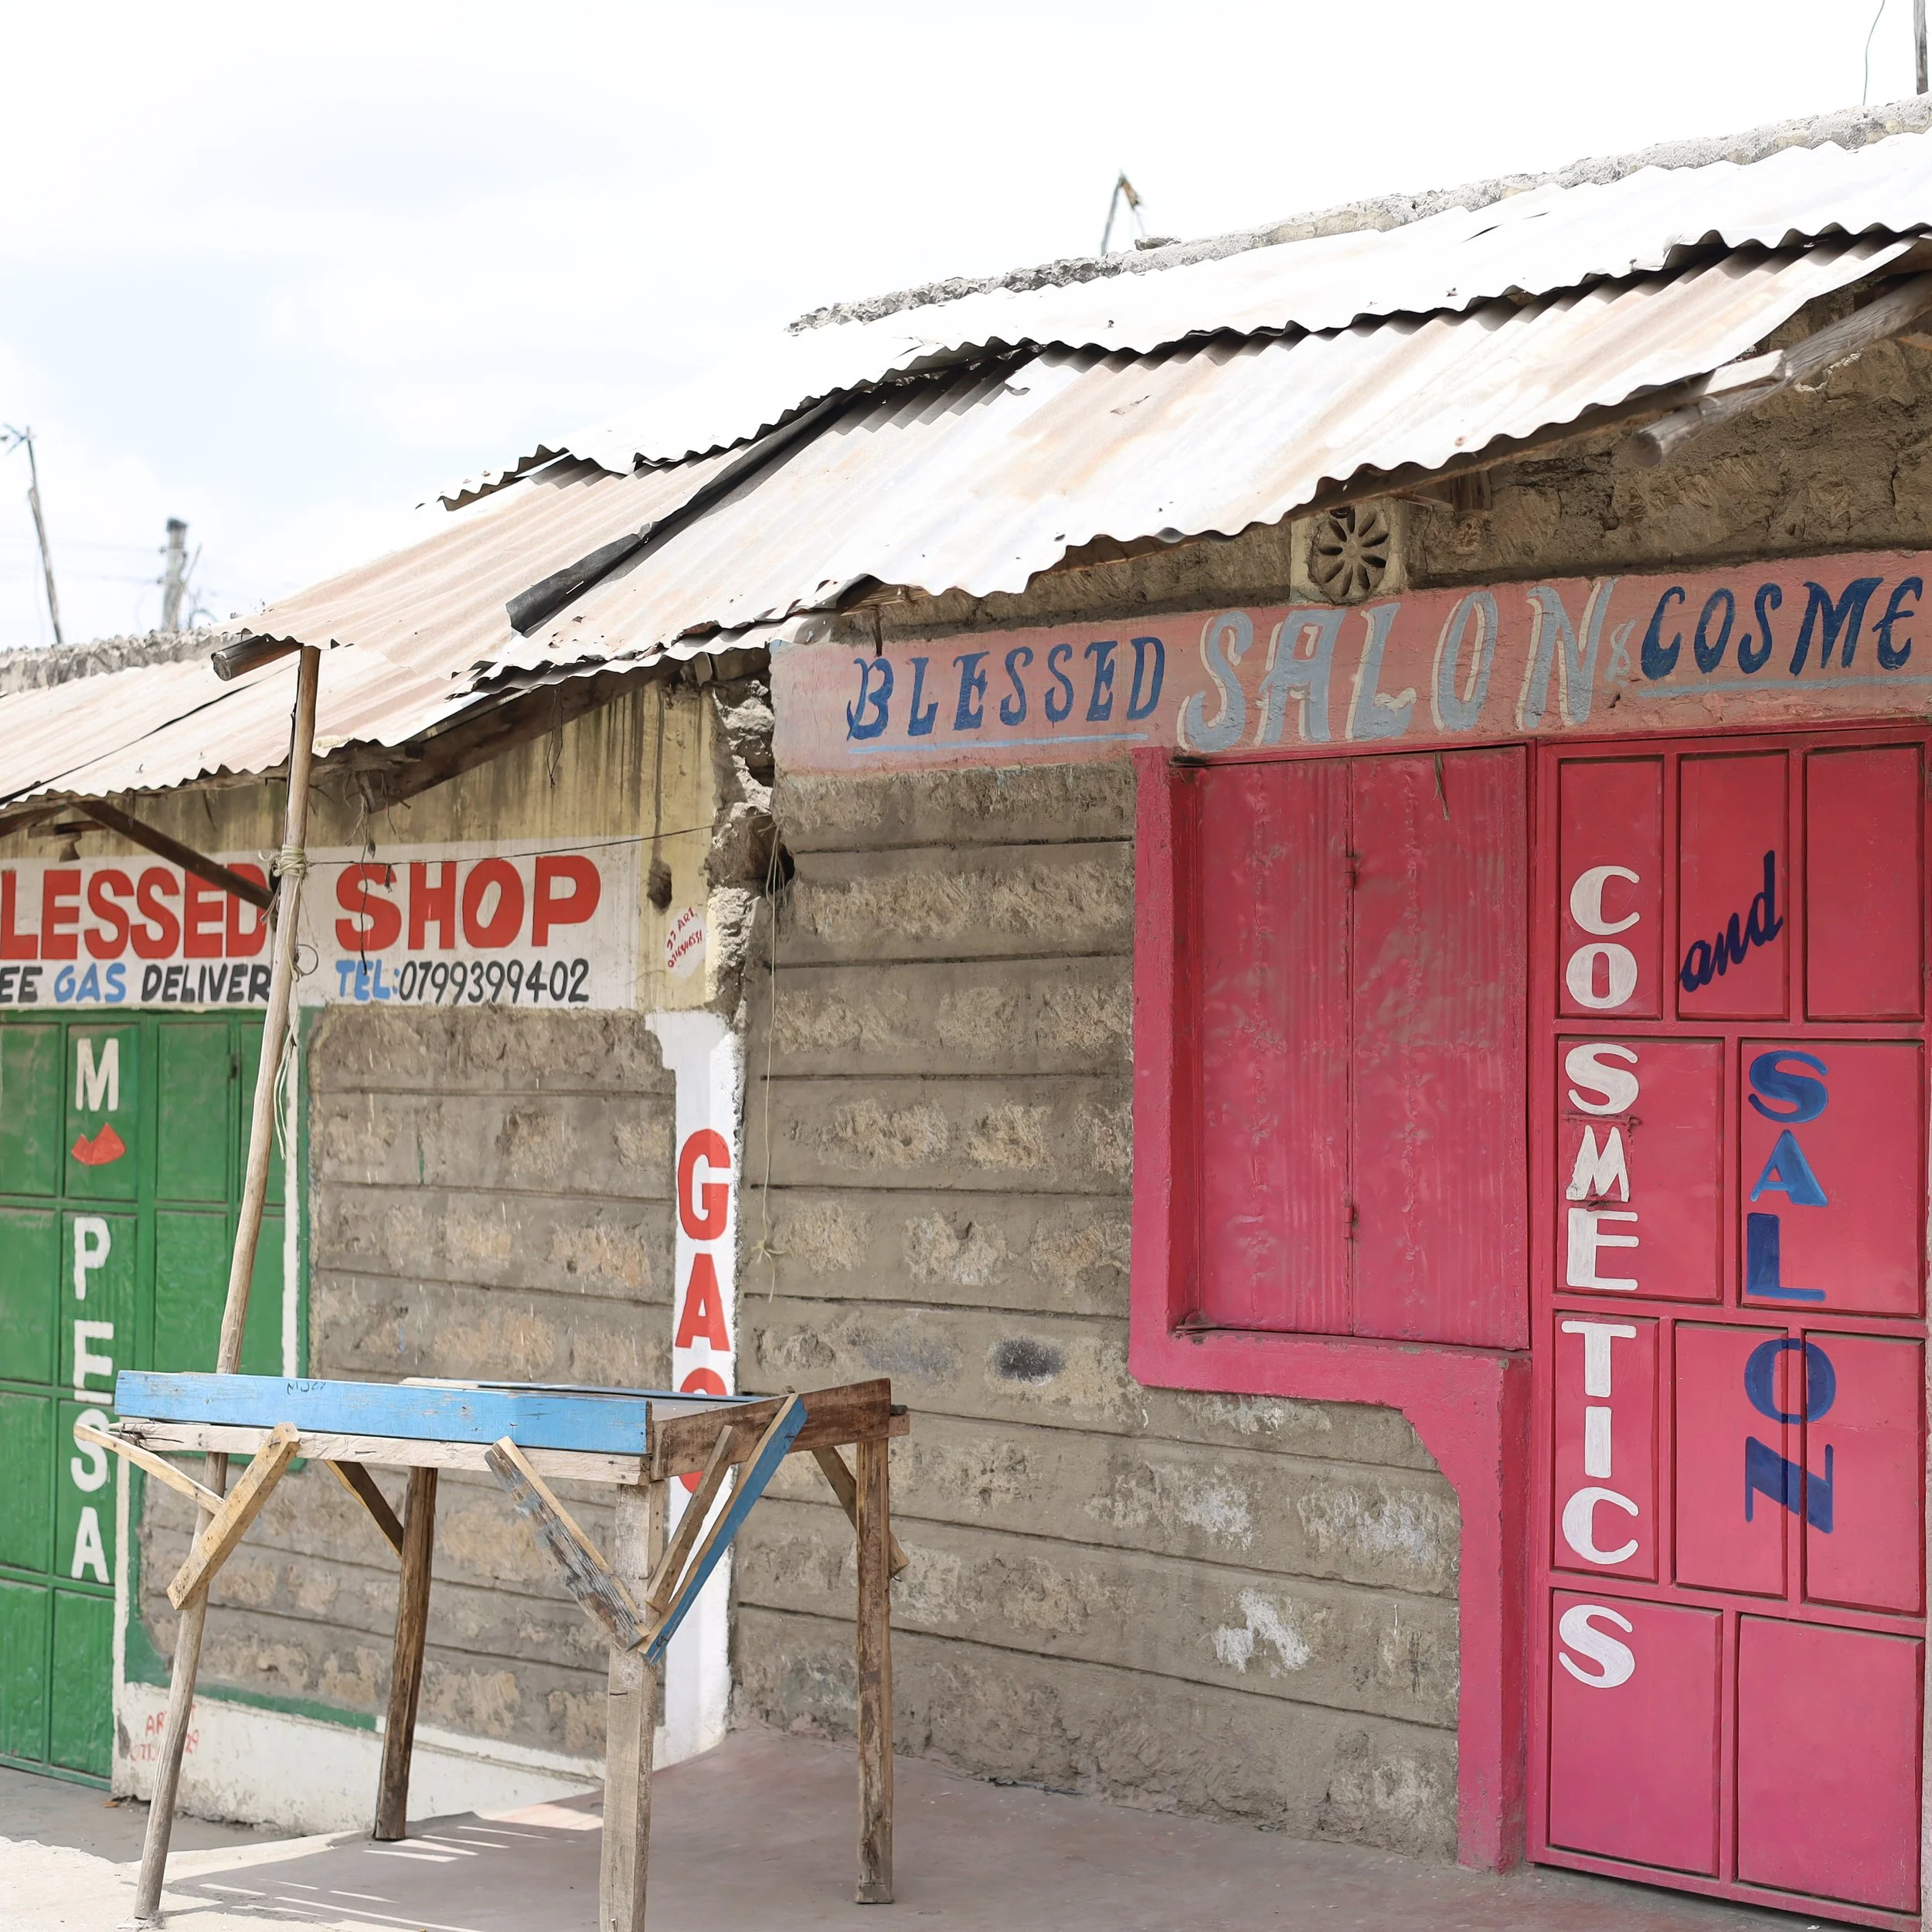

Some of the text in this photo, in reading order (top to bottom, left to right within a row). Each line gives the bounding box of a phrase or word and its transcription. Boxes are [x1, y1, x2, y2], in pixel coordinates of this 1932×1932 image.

[846, 636, 1165, 741] BLESSED
[1177, 577, 1620, 753] SALON
[1641, 577, 1923, 680] COSME
[0, 855, 601, 960] LESSED SHOP
[0, 966, 43, 1003] EE
[54, 962, 126, 1003] GAS
[677, 906, 695, 932] ART
[1558, 865, 1641, 1689] COSMETICS
[1679, 850, 1836, 1535] and SALON
[70, 1038, 120, 1584] M PESA
